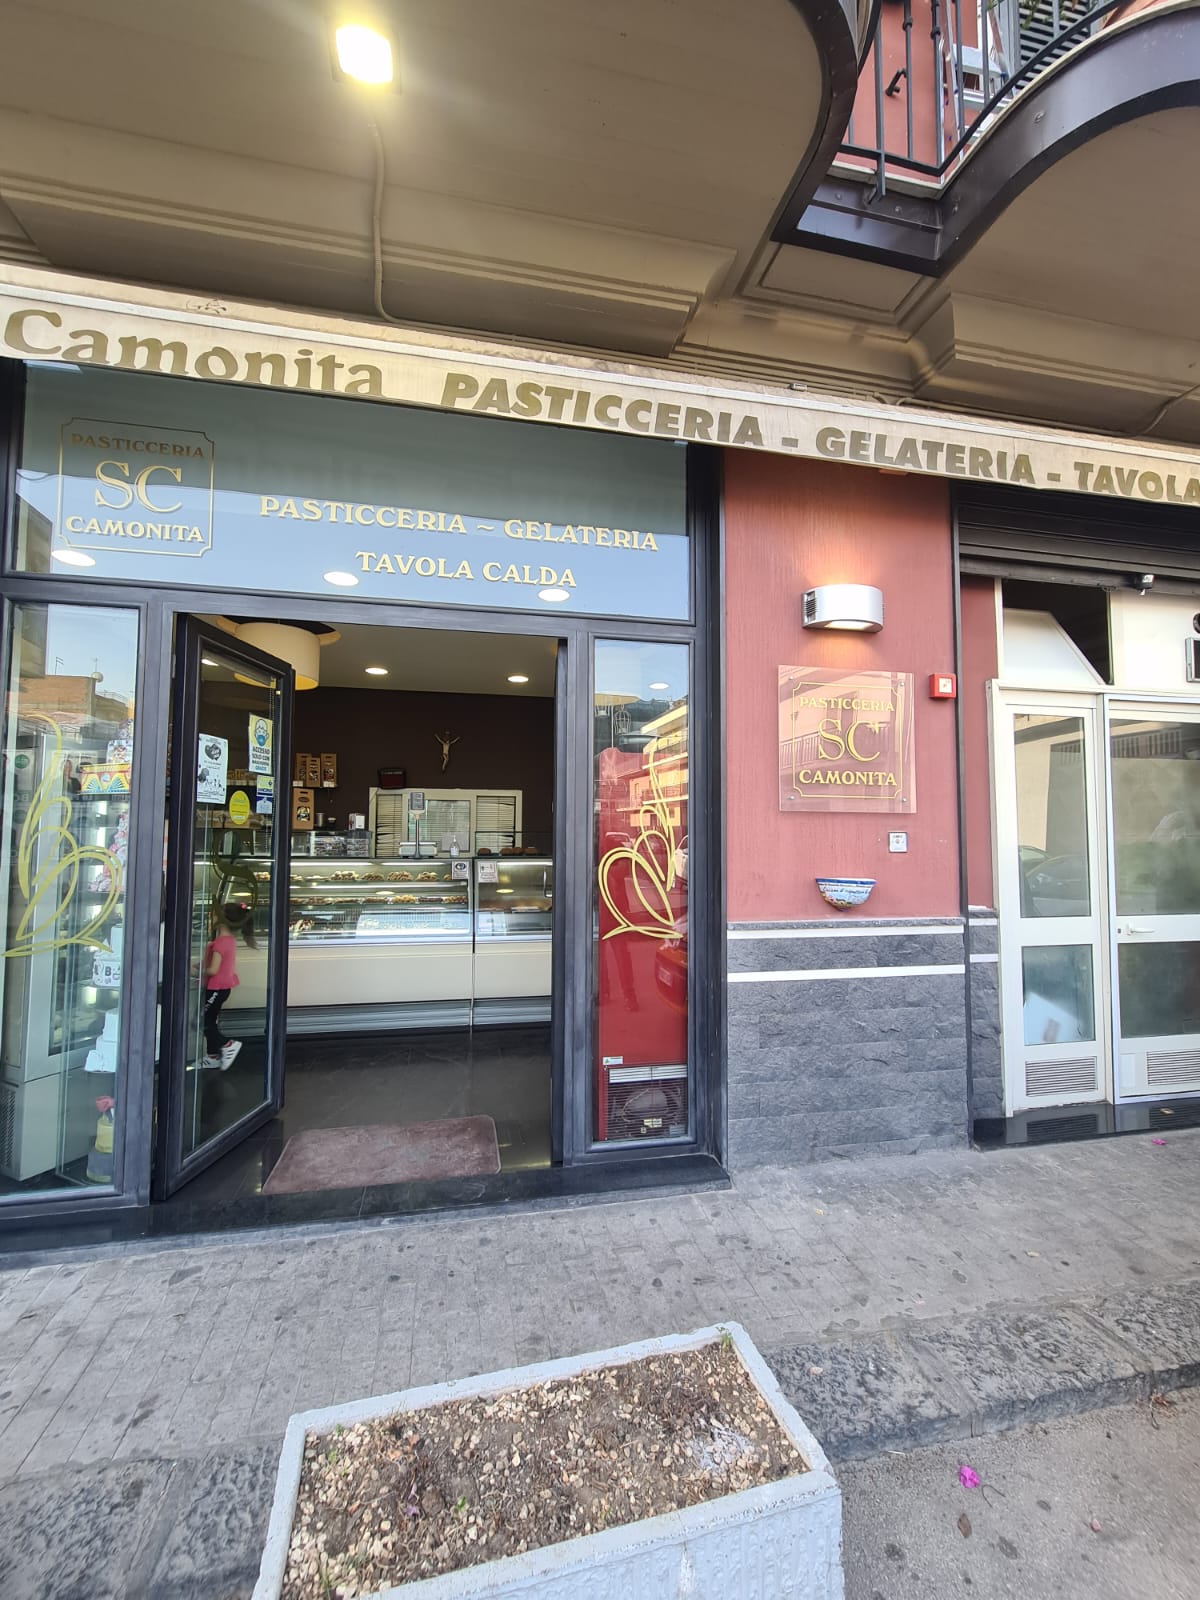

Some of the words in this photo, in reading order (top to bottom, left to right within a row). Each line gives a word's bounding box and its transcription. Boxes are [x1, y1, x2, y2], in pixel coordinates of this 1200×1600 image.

[4, 308, 386, 398] Camonita
[440, 372, 763, 447] PASTICCERIA
[815, 427, 1036, 485] GELATERIA
[1073, 461, 1200, 504] TAVOLA
[70, 433, 204, 459] PASTICCERIA
[94, 460, 183, 513] SC
[66, 515, 205, 543] CAMONITA
[259, 495, 467, 535] PASTICCERIA
[503, 519, 659, 551] GELATERIA
[355, 551, 474, 580] TAVOLA
[482, 562, 577, 588] CALDA
[799, 696, 895, 712] PASTICCERIA
[817, 718, 881, 762] SC
[799, 769, 897, 787] CAMONITA
